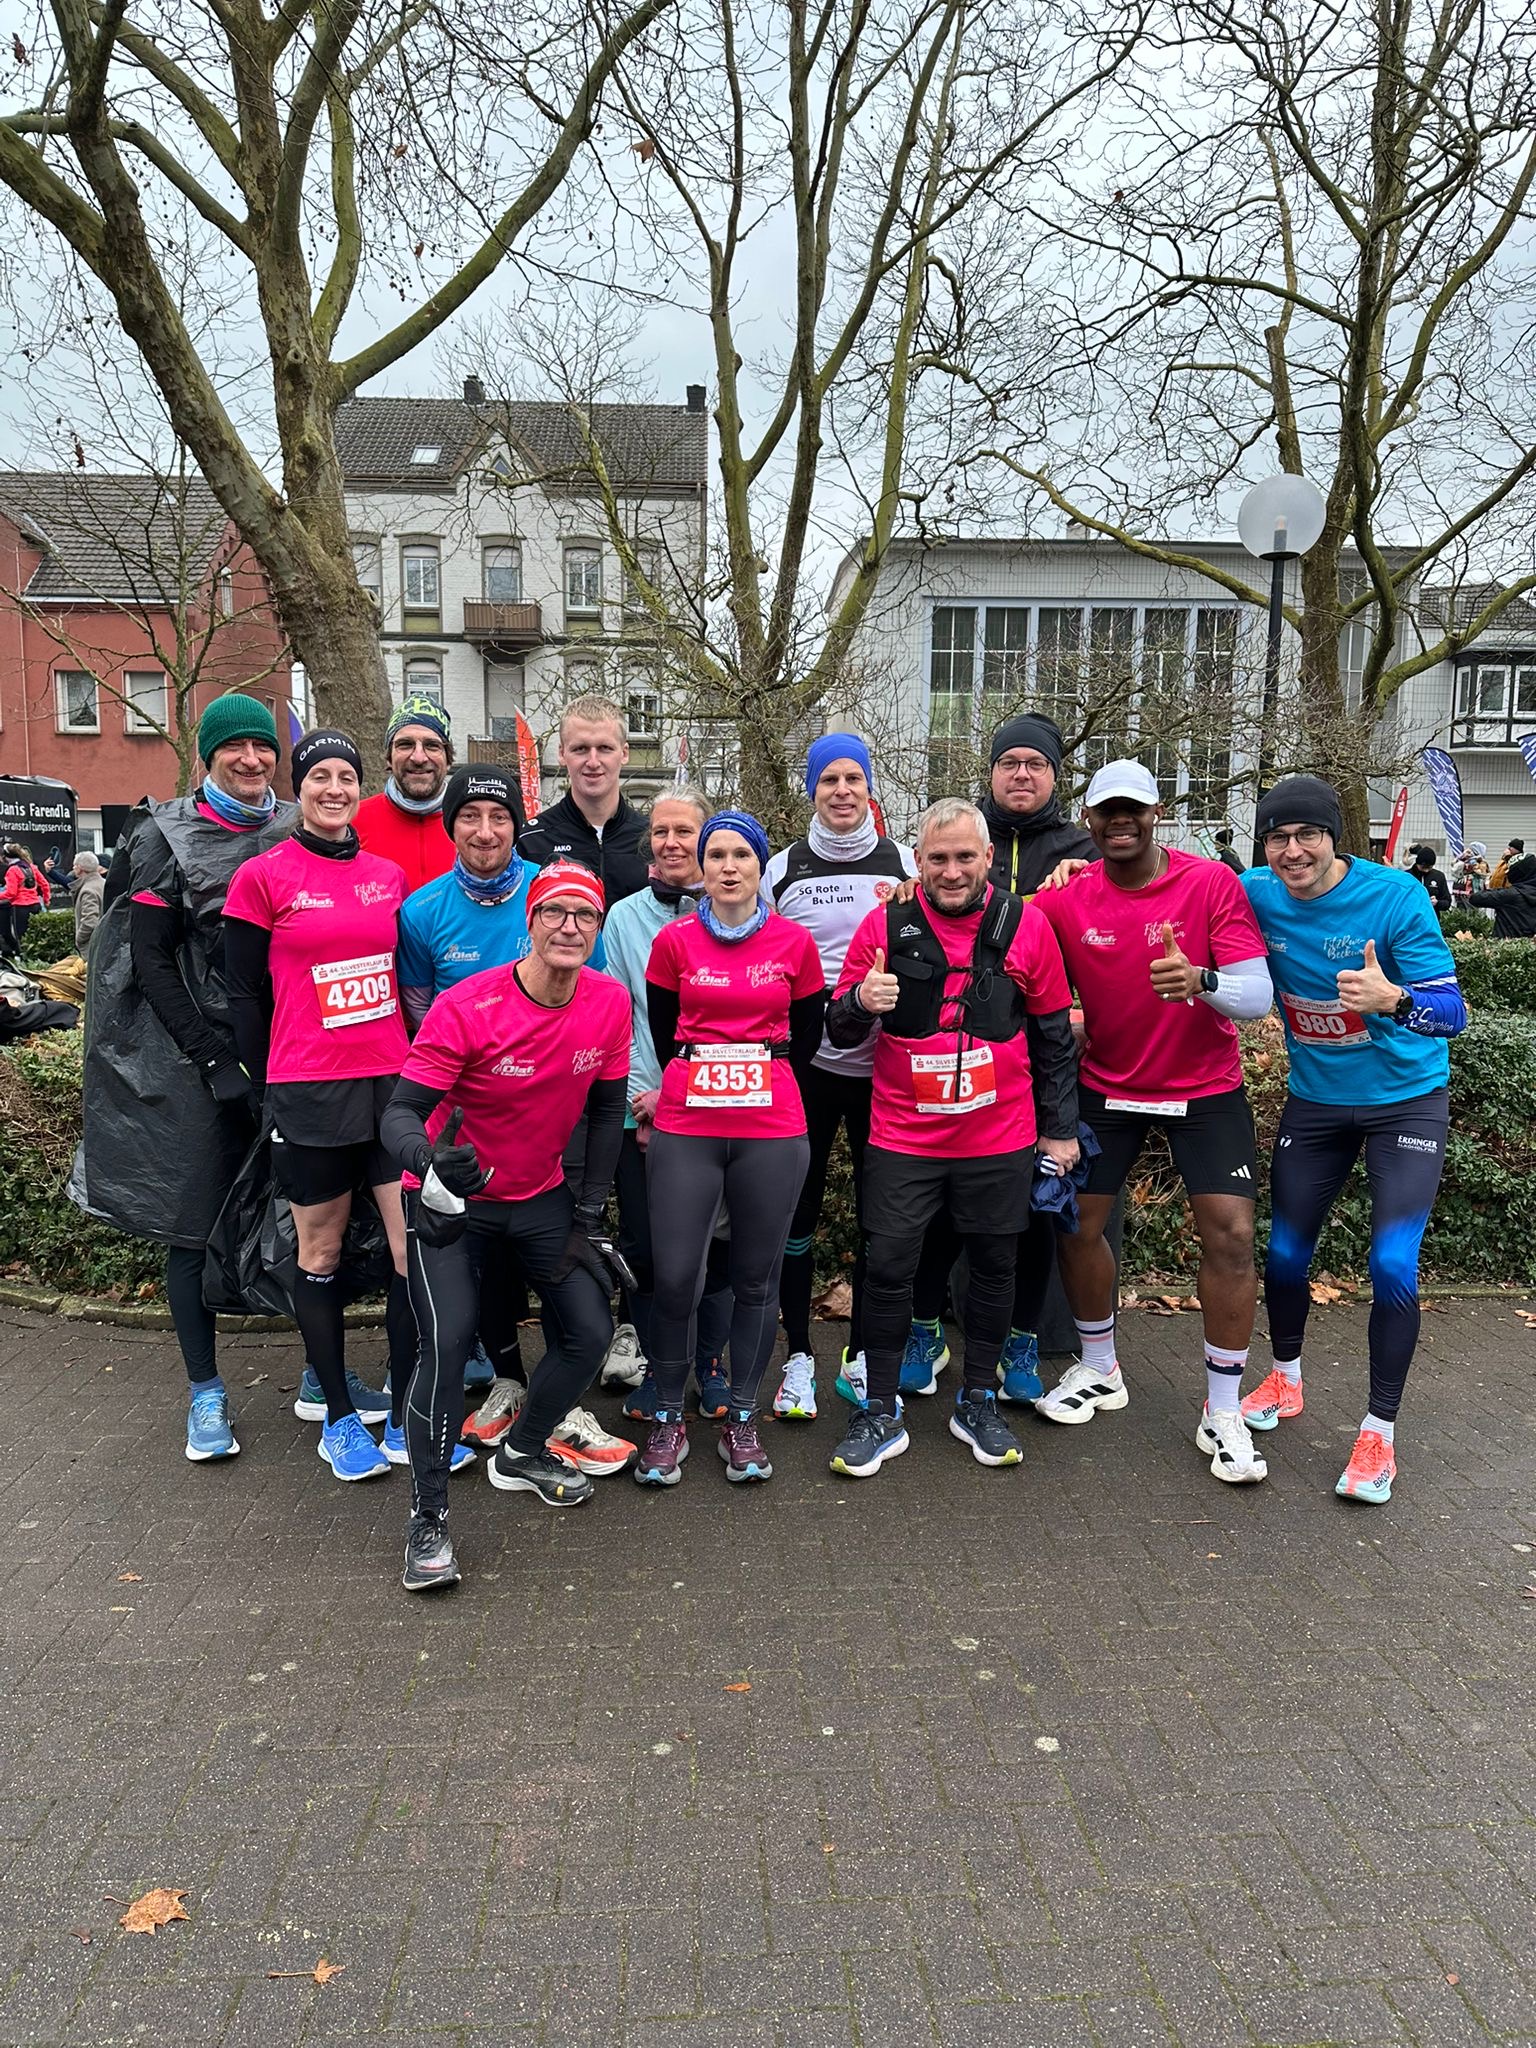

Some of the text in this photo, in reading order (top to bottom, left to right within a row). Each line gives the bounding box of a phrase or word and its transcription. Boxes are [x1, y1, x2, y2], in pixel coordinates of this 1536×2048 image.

[299, 737, 356, 761] GARMIN
[468, 787, 507, 798] AMELAND
[0, 801, 71, 818] Janis Farendla
[553, 844, 572, 852] JAKO
[799, 886, 812, 896] SG
[816, 884, 840, 894] Rote
[327, 974, 390, 1009] 4209
[1295, 1011, 1347, 1035] 980
[694, 1063, 763, 1091] 4353
[936, 1071, 973, 1099] 78
[1398, 1135, 1438, 1149] ERDINGER
